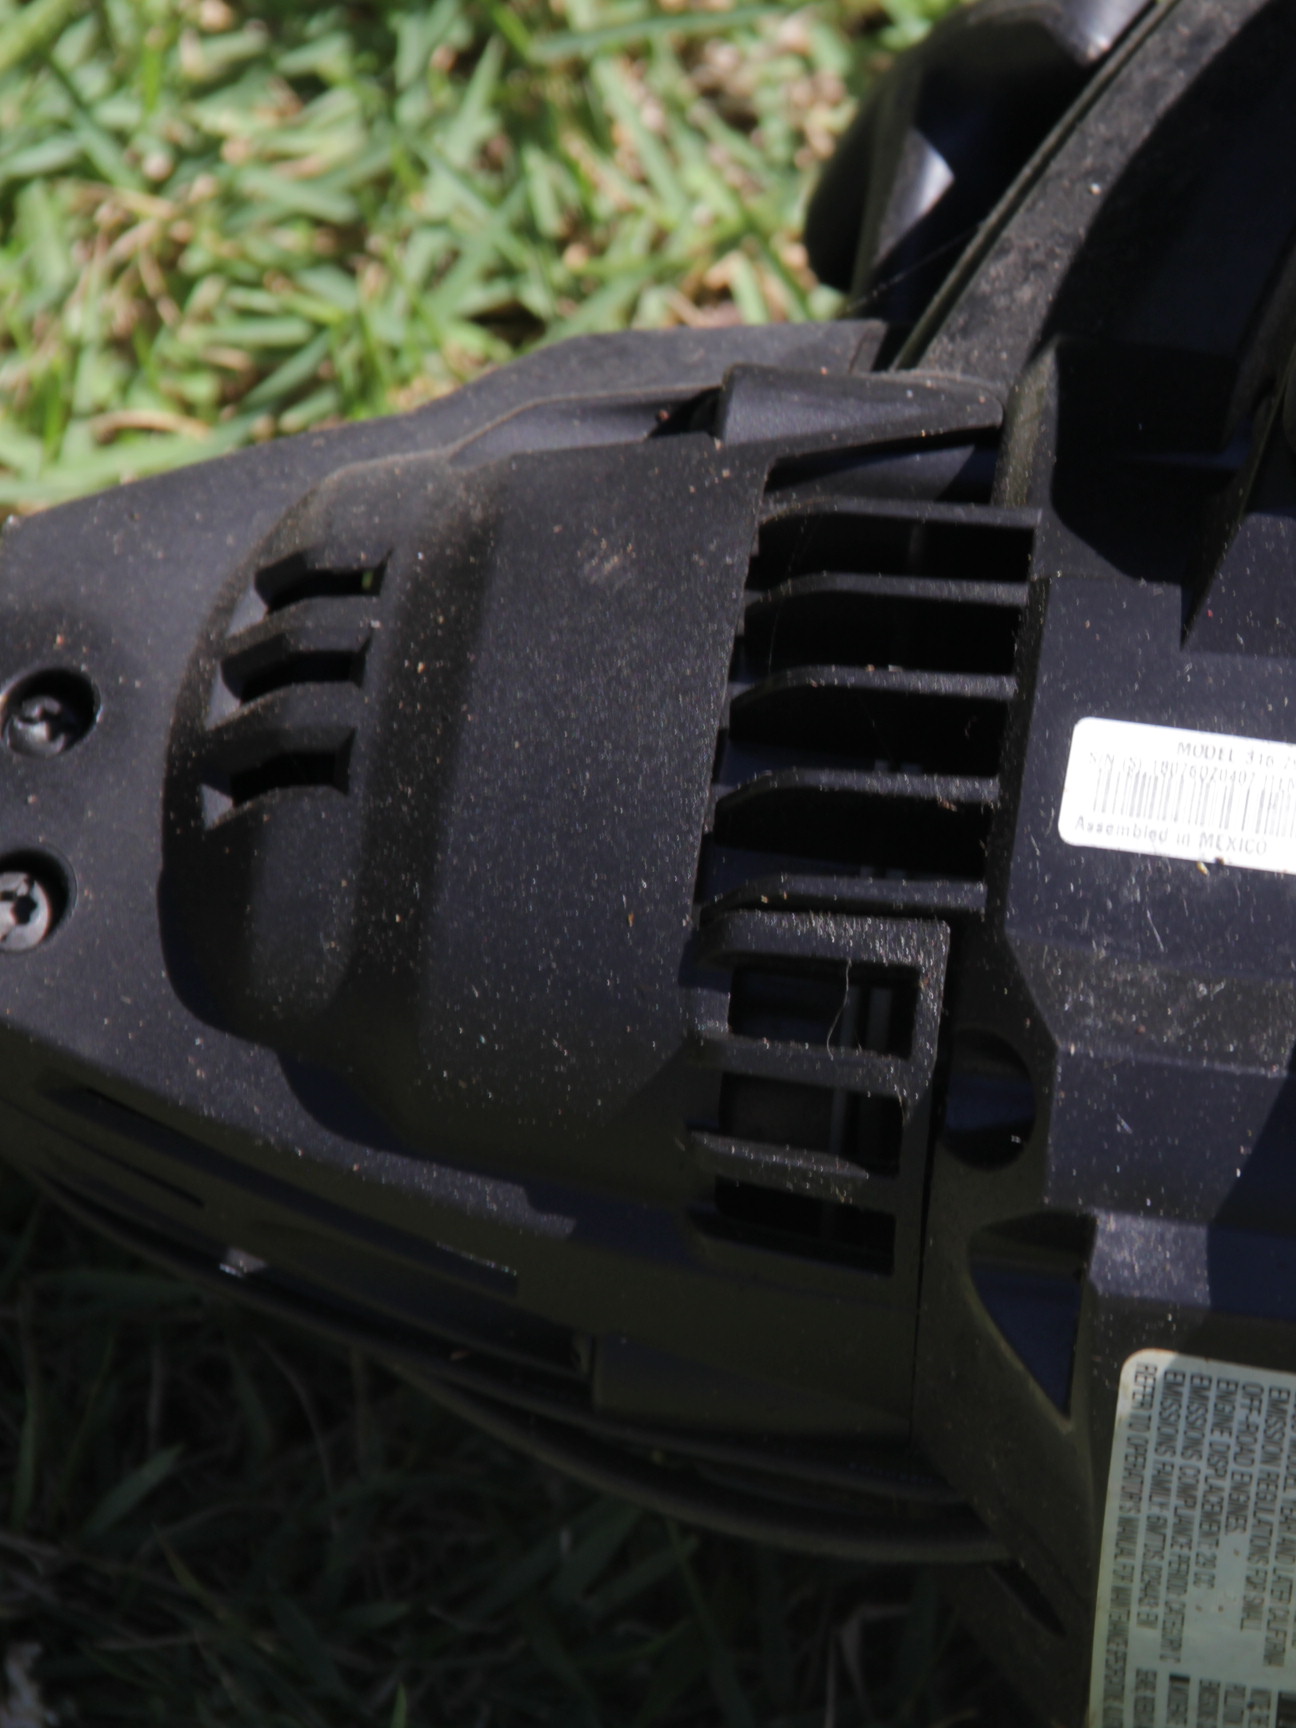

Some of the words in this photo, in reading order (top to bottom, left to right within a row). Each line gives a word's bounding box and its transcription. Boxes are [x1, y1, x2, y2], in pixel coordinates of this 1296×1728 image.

[1177, 742, 1235, 762] MODEL
[1075, 816, 1169, 842] Assembled
[1176, 834, 1190, 847] in
[1199, 832, 1267, 855] MEXICO
[1131, 1363, 1157, 1411] REFER
[1155, 1368, 1186, 1458] EMISSIONS
[1181, 1372, 1212, 1463] EMISSIONS
[1210, 1377, 1239, 1438] ENGINE
[1129, 1411, 1152, 1434] TO
[1232, 1381, 1264, 1468] OFF-ROAD
[1259, 1385, 1291, 1467] EMISSION
[1171, 1464, 1202, 1552] COMPLIANCE
[1223, 1470, 1253, 1538] ENGINES.
[1247, 1469, 1280, 1566] REGULATIONS
[1191, 1570, 1214, 1590] CC
[1244, 1566, 1268, 1594] FOR
